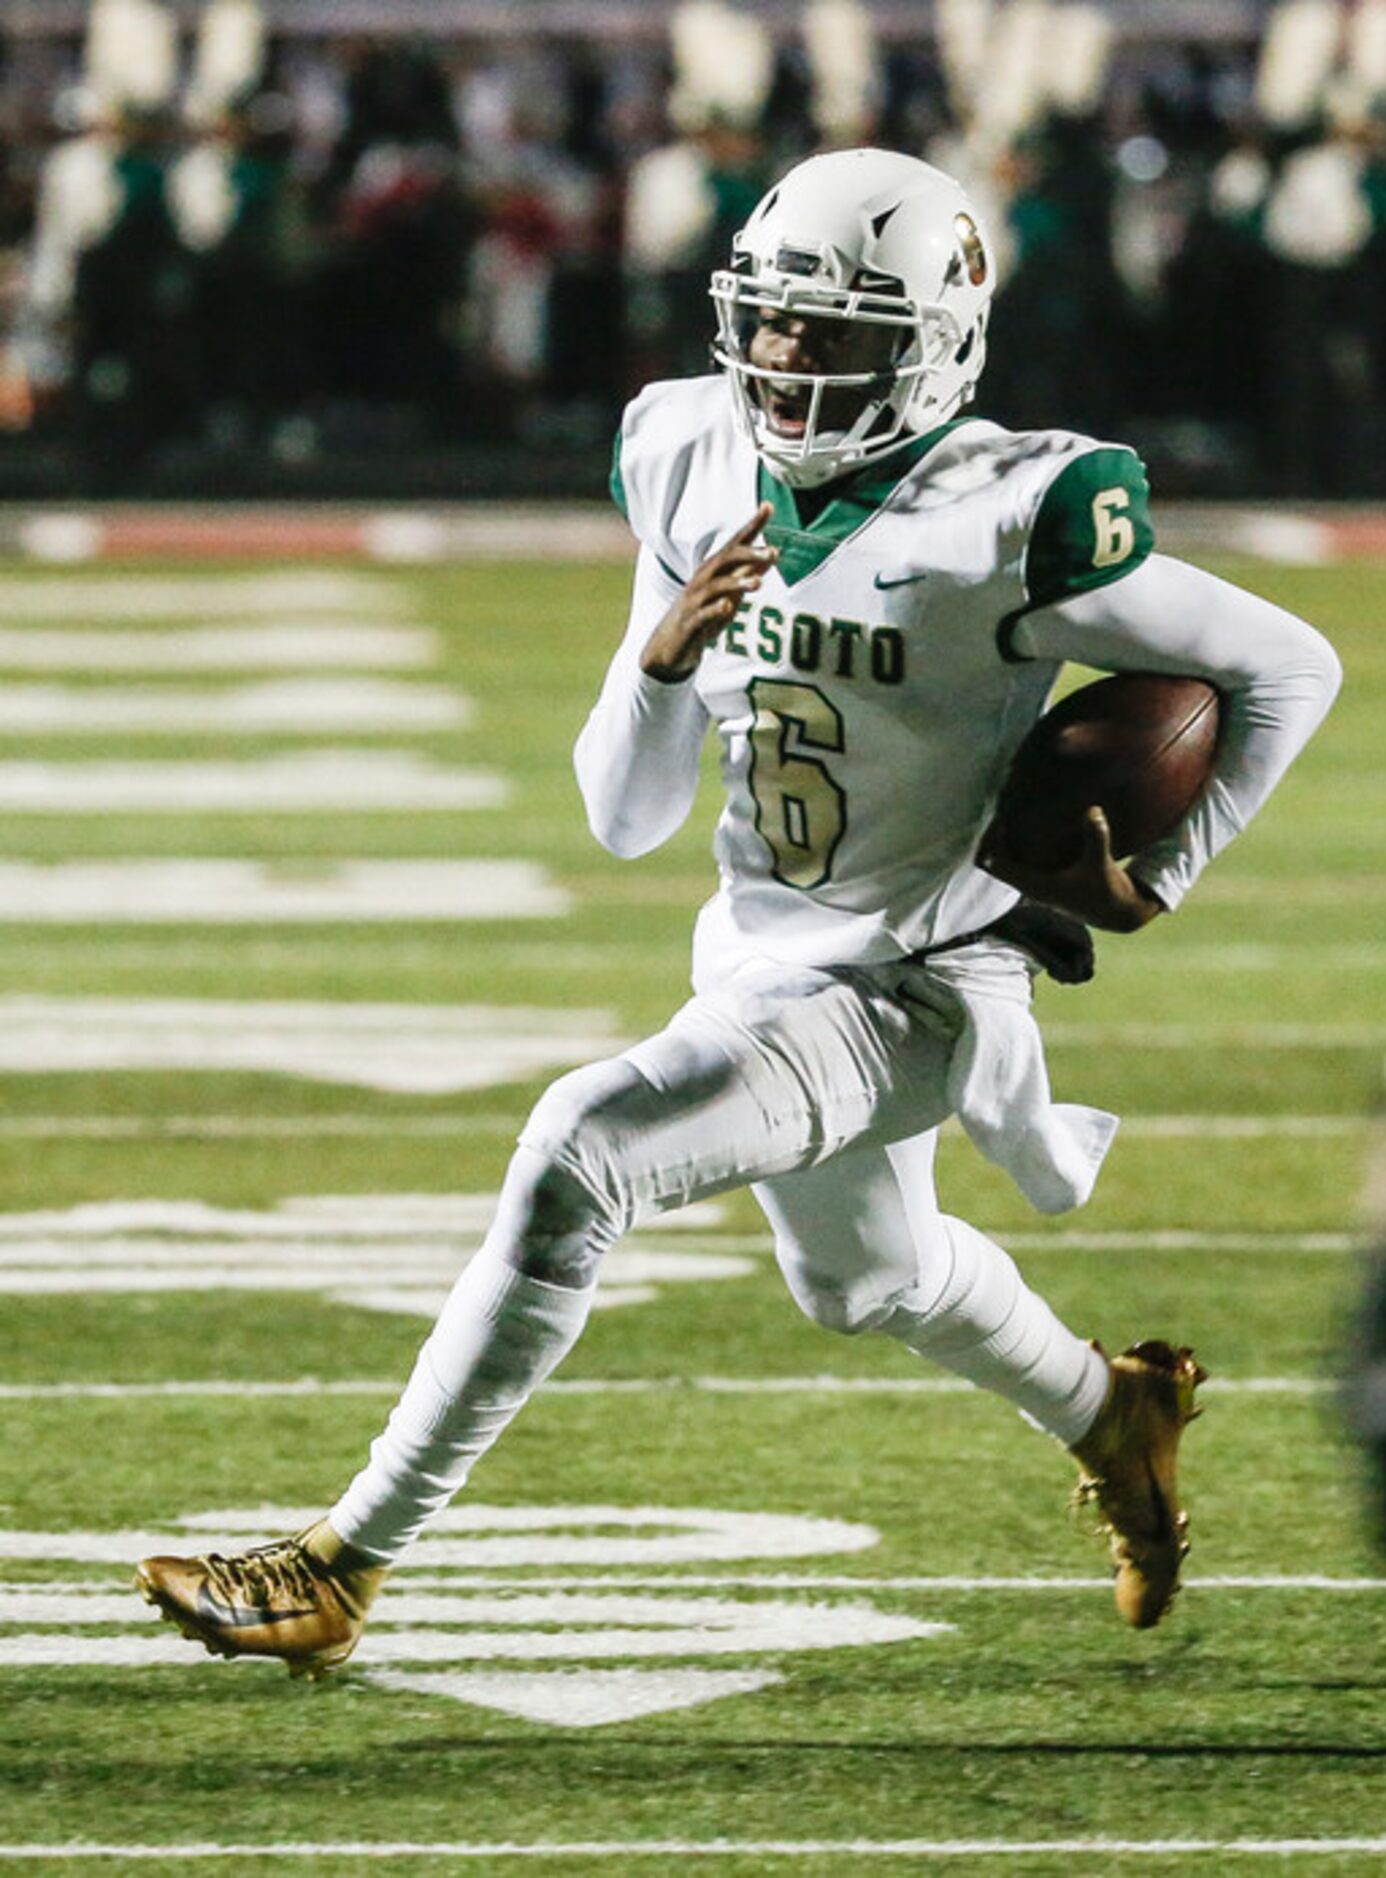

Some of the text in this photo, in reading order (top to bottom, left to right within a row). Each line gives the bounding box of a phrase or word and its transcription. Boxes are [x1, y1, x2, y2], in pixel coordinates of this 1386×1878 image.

[1092, 486, 1133, 568] 6
[704, 601, 905, 684] ESOTO
[747, 677, 847, 889] 6
